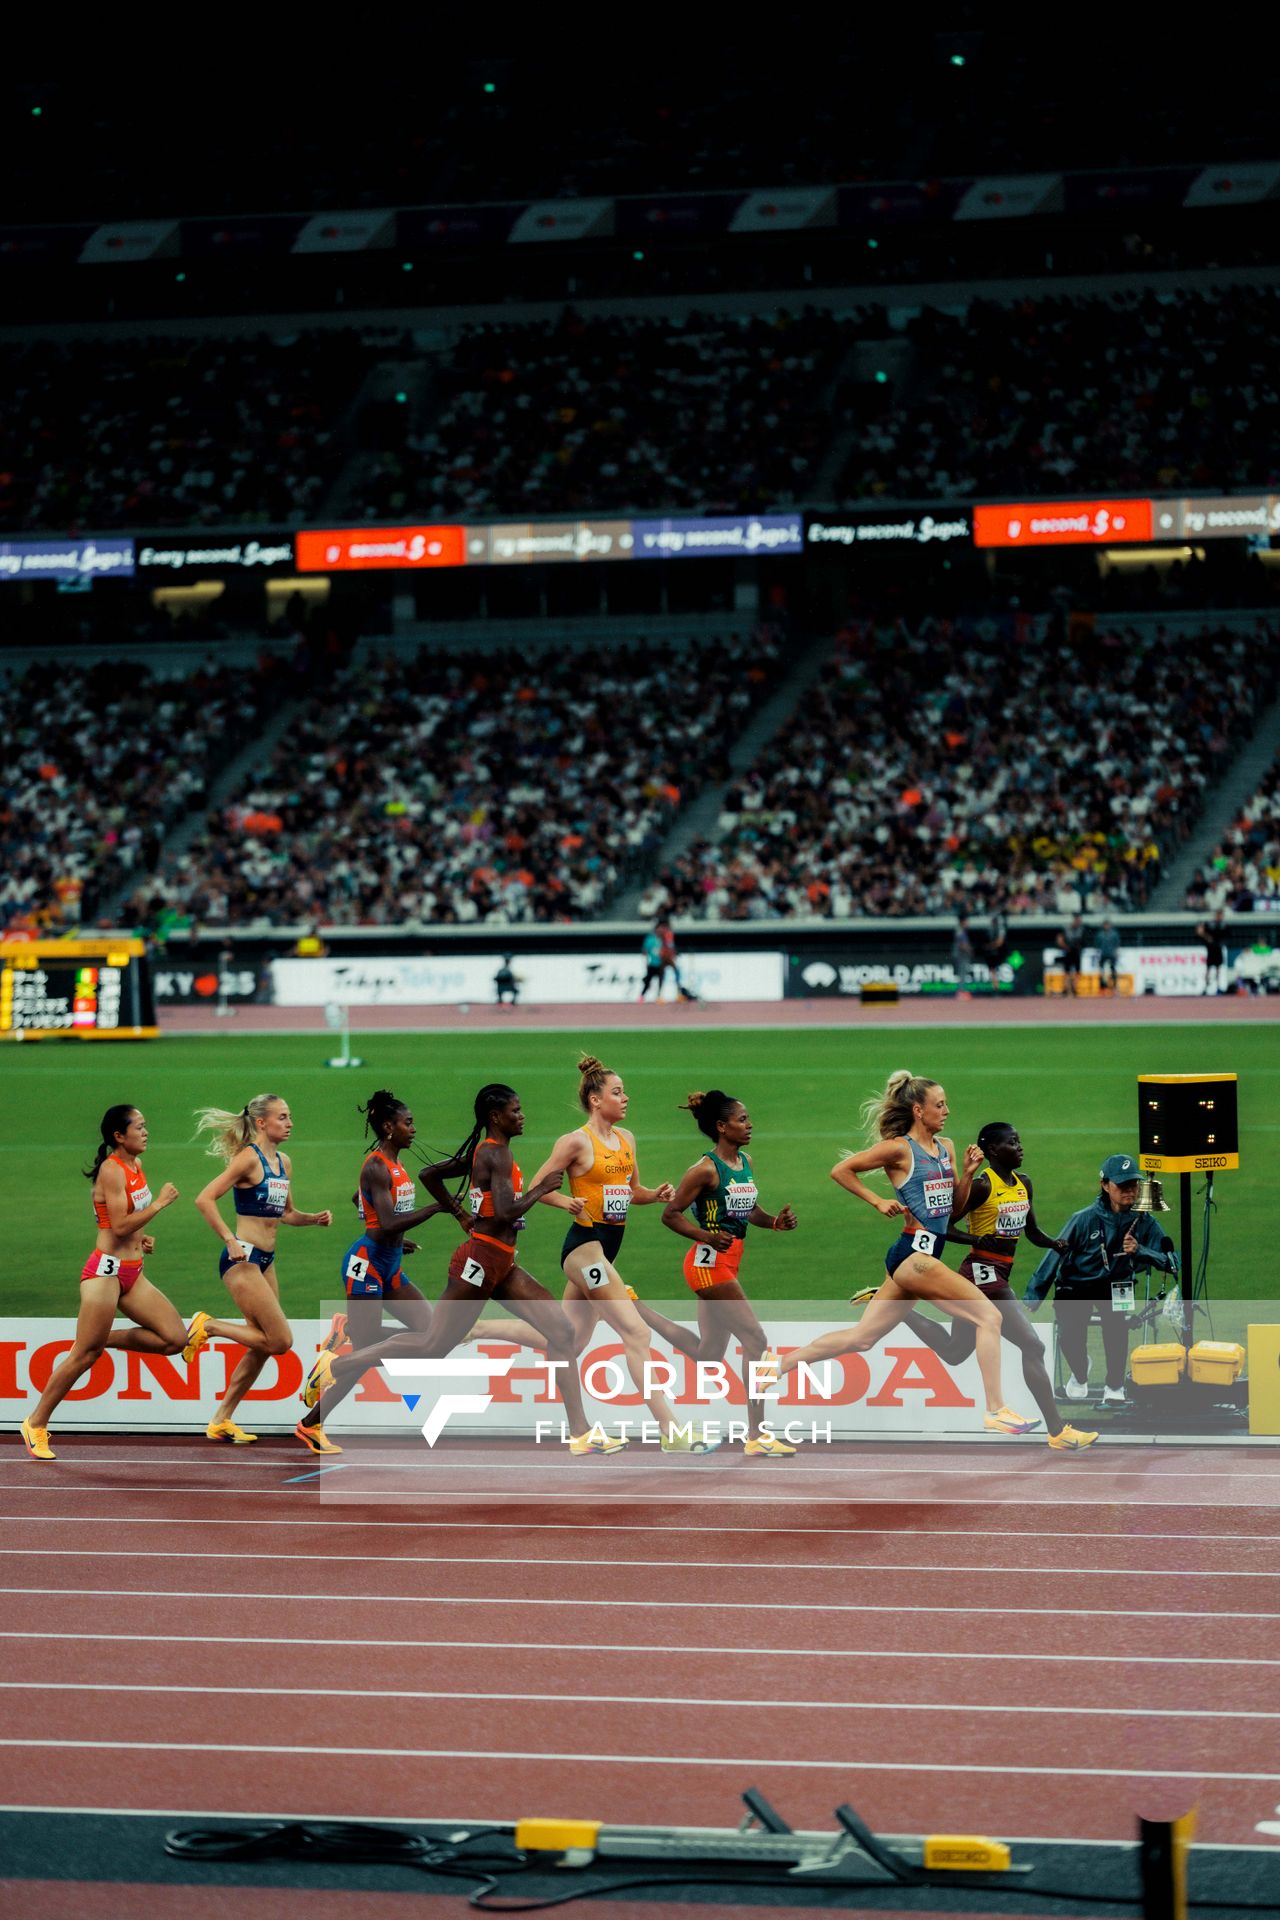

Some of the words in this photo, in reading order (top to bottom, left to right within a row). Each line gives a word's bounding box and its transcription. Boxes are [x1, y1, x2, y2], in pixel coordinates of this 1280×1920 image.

[808, 523, 855, 545] Every
[139, 547, 185, 568] Every
[838, 964, 910, 983] WORLD
[1144, 1157, 1162, 1169] SEIKO
[1194, 1156, 1227, 1169] SEIKO
[918, 1234, 930, 1250] 8
[700, 1247, 711, 1264] 2
[103, 1258, 115, 1275] 3
[351, 1261, 362, 1277] 4
[468, 1263, 480, 1279] 7
[979, 1265, 989, 1281] 5
[588, 1267, 602, 1285] 9
